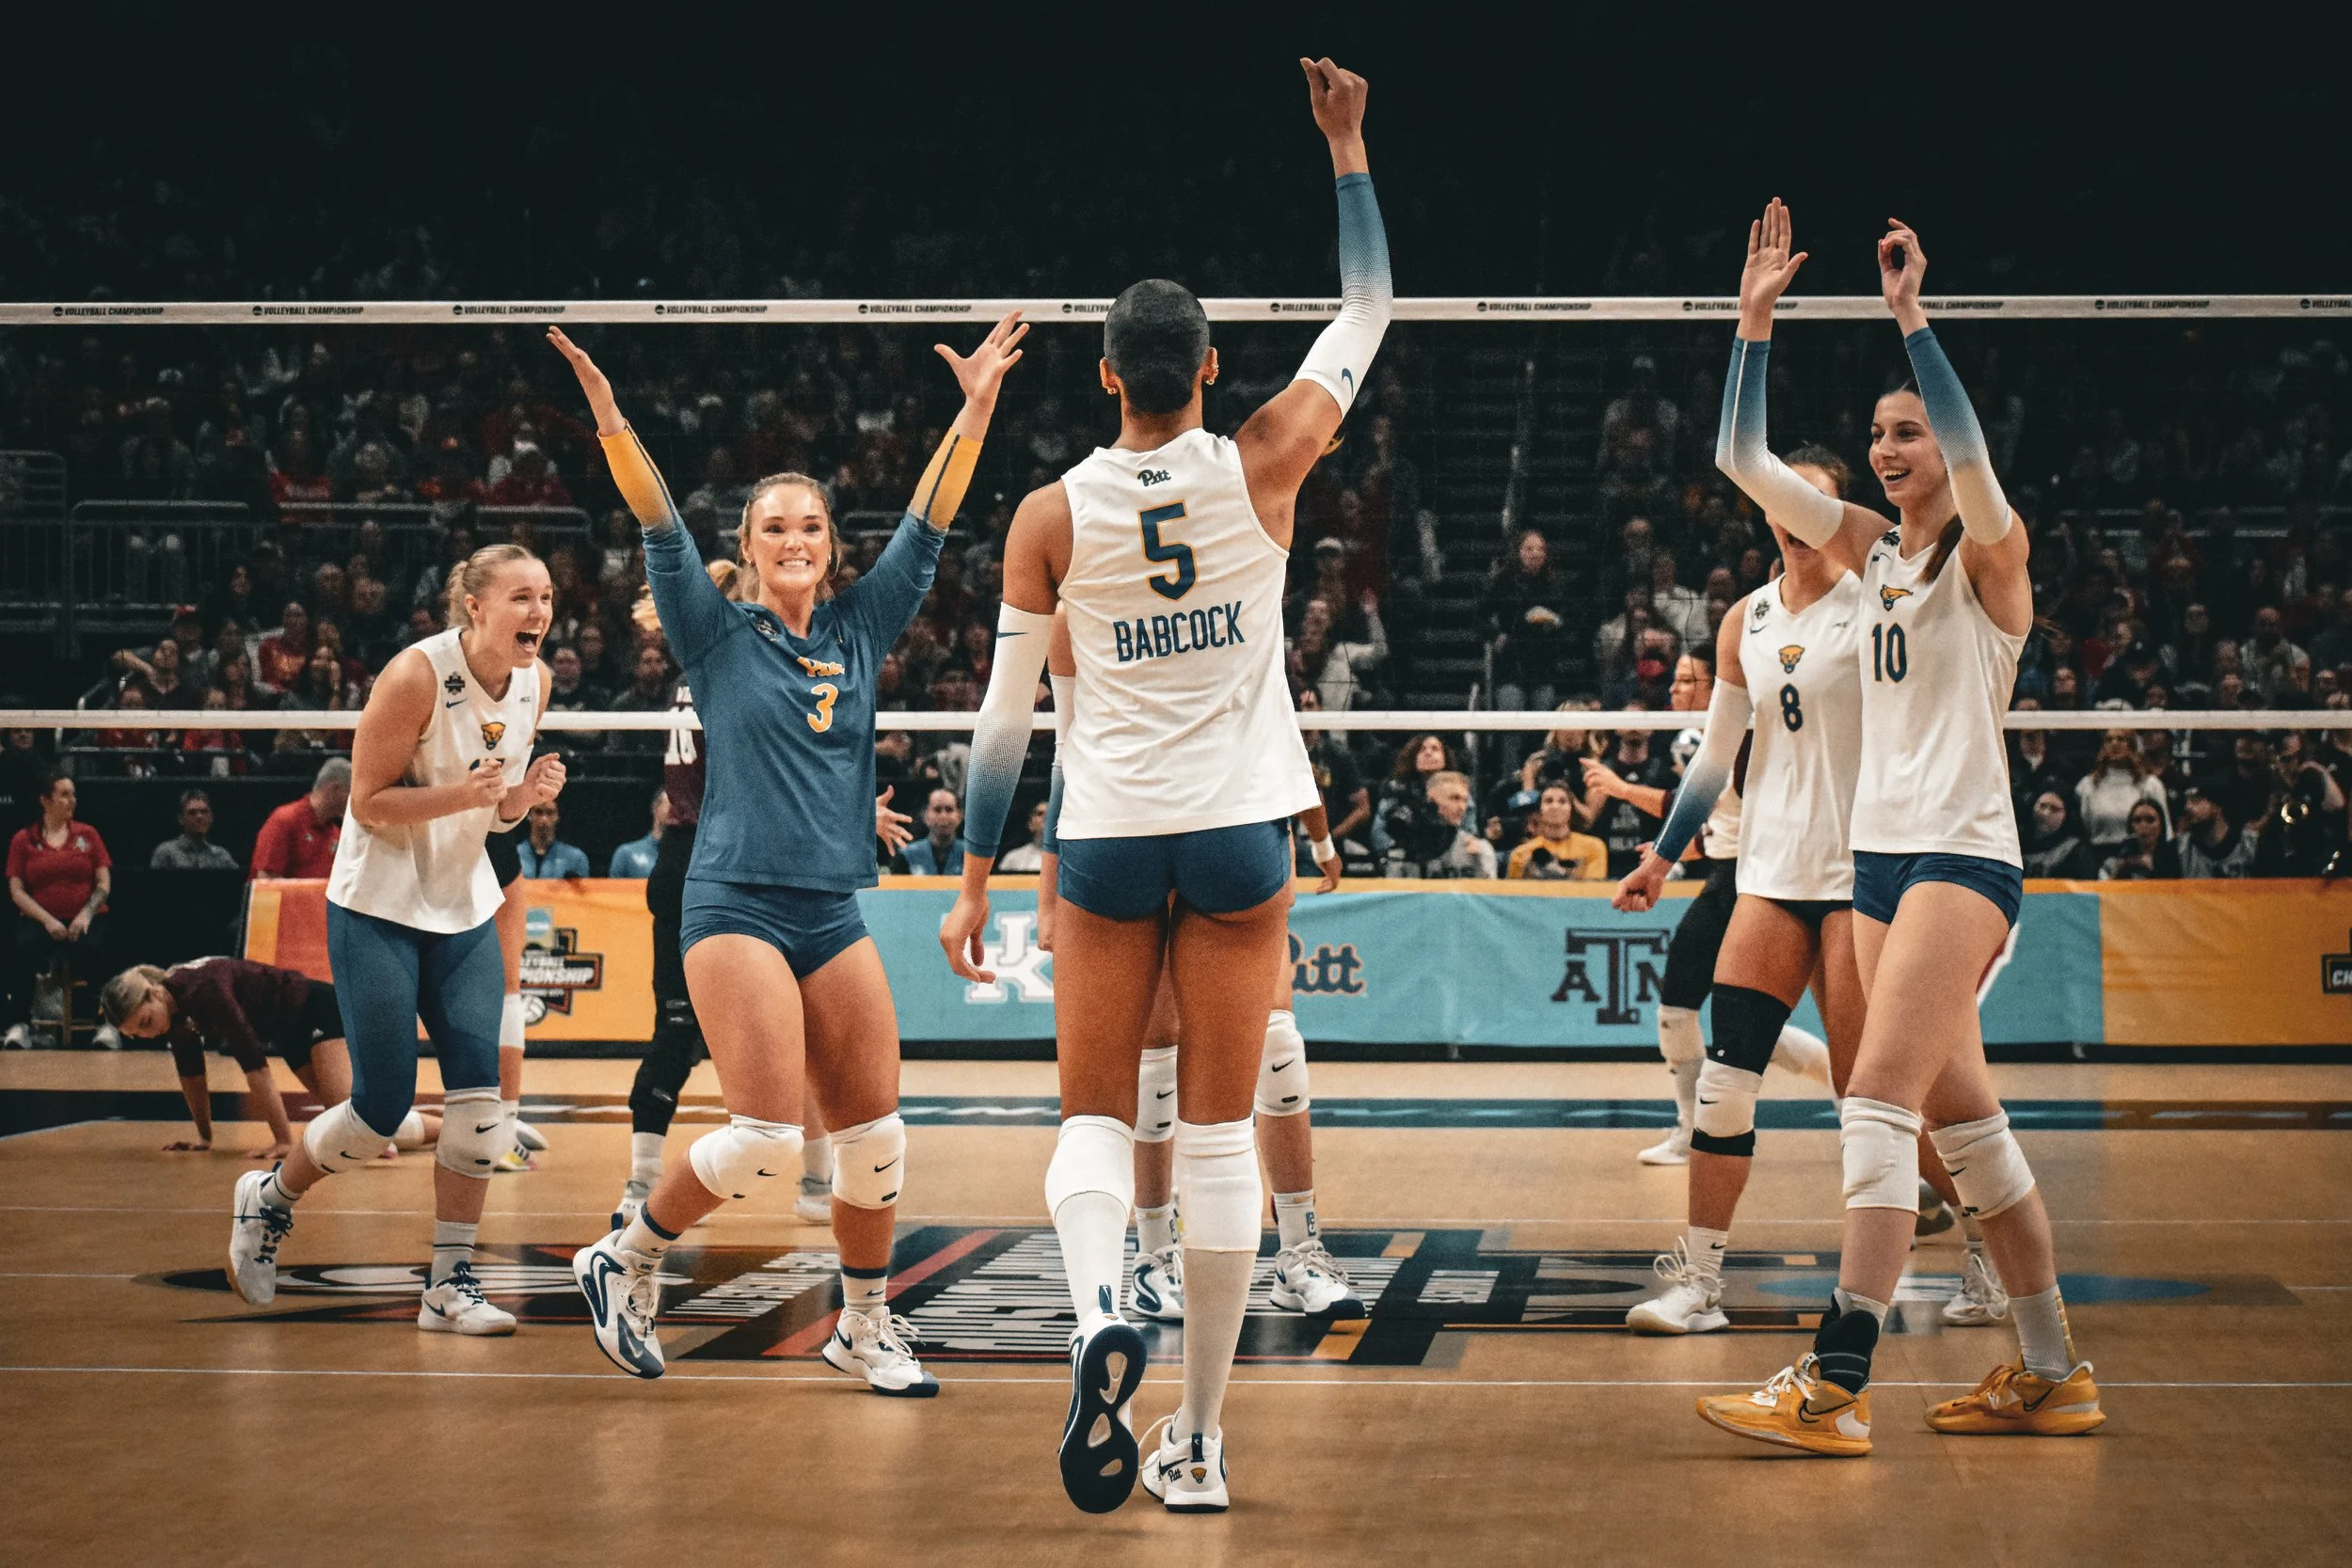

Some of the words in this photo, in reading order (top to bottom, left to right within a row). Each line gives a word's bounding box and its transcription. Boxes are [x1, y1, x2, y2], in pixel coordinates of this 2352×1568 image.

[465, 306, 507, 314] VOLLEYBALL
[509, 306, 565, 314] CHAMPIONSHIP
[666, 306, 709, 314] VOLLEYBALL
[870, 305, 912, 313] VOLLEYBALL
[914, 305, 972, 313] CHAMPIONSHIP
[1489, 303, 1532, 311] VOLLEYBALL
[1534, 303, 1592, 311] CHAMPIONSHIP
[1694, 302, 1738, 310] VOLLEYBALL
[2106, 301, 2149, 309] VOLLEYBALL
[65, 308, 106, 316] VOLLEYBALL
[108, 308, 164, 316] CHAMPIONSHIP
[264, 307, 306, 315] VOLLEYBALL
[308, 307, 364, 315] CHAMPIONSHIP
[1137, 469, 1171, 486] Pitt
[1137, 499, 1200, 602] 5
[1113, 601, 1245, 662] BABCOCK
[1871, 622, 1908, 684] 10
[806, 682, 838, 734] 3
[1779, 683, 1804, 733] 8
[1287, 931, 1367, 995] itt
[1168, 1467, 1183, 1482] Pitt
